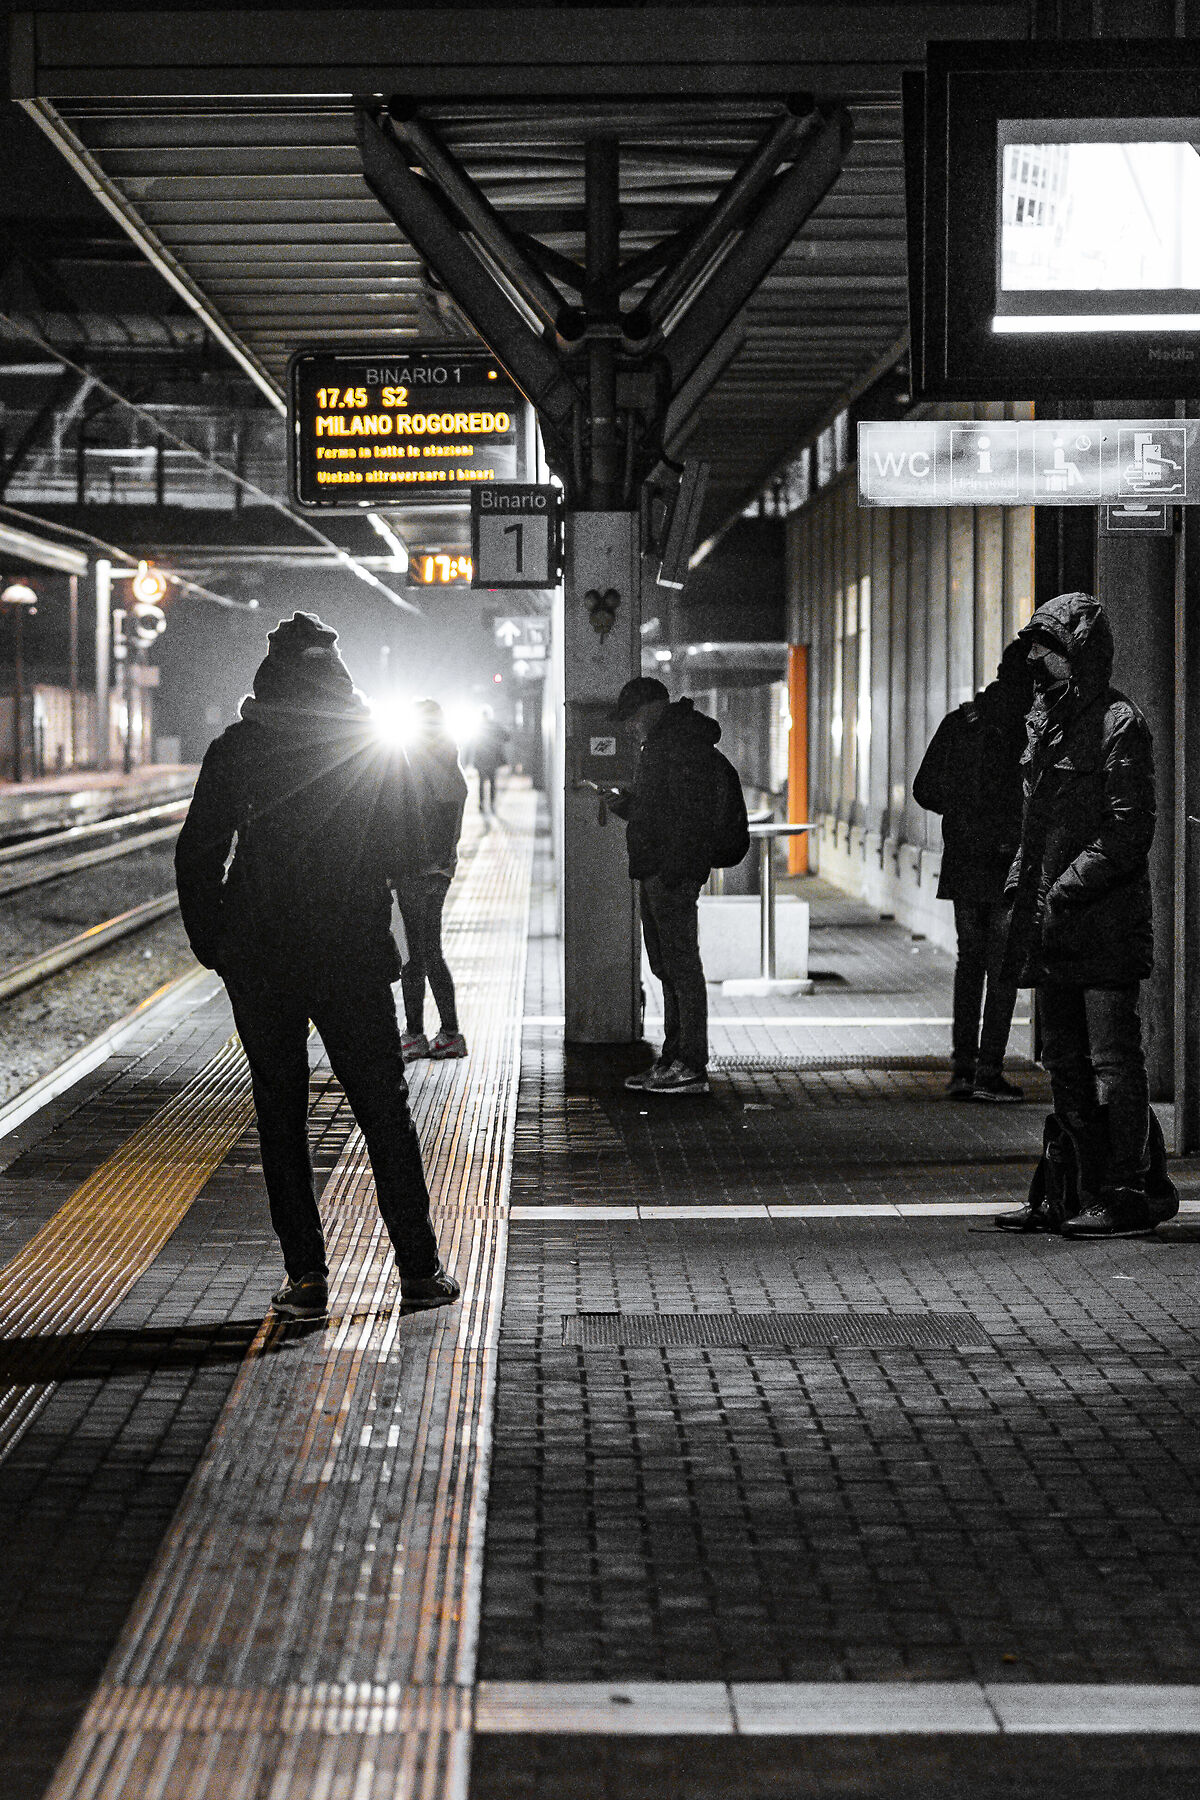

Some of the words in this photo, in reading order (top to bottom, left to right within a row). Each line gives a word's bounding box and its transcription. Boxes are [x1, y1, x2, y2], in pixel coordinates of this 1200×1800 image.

[366, 368, 447, 384] BINARIO
[453, 368, 461, 383] 1
[316, 387, 368, 408] 17.45
[382, 386, 408, 407] S2
[316, 414, 393, 436] MILANO
[396, 412, 510, 435] ROGOREDO
[873, 451, 930, 478] WC
[481, 491, 546, 508] Binario
[504, 523, 523, 573] 1
